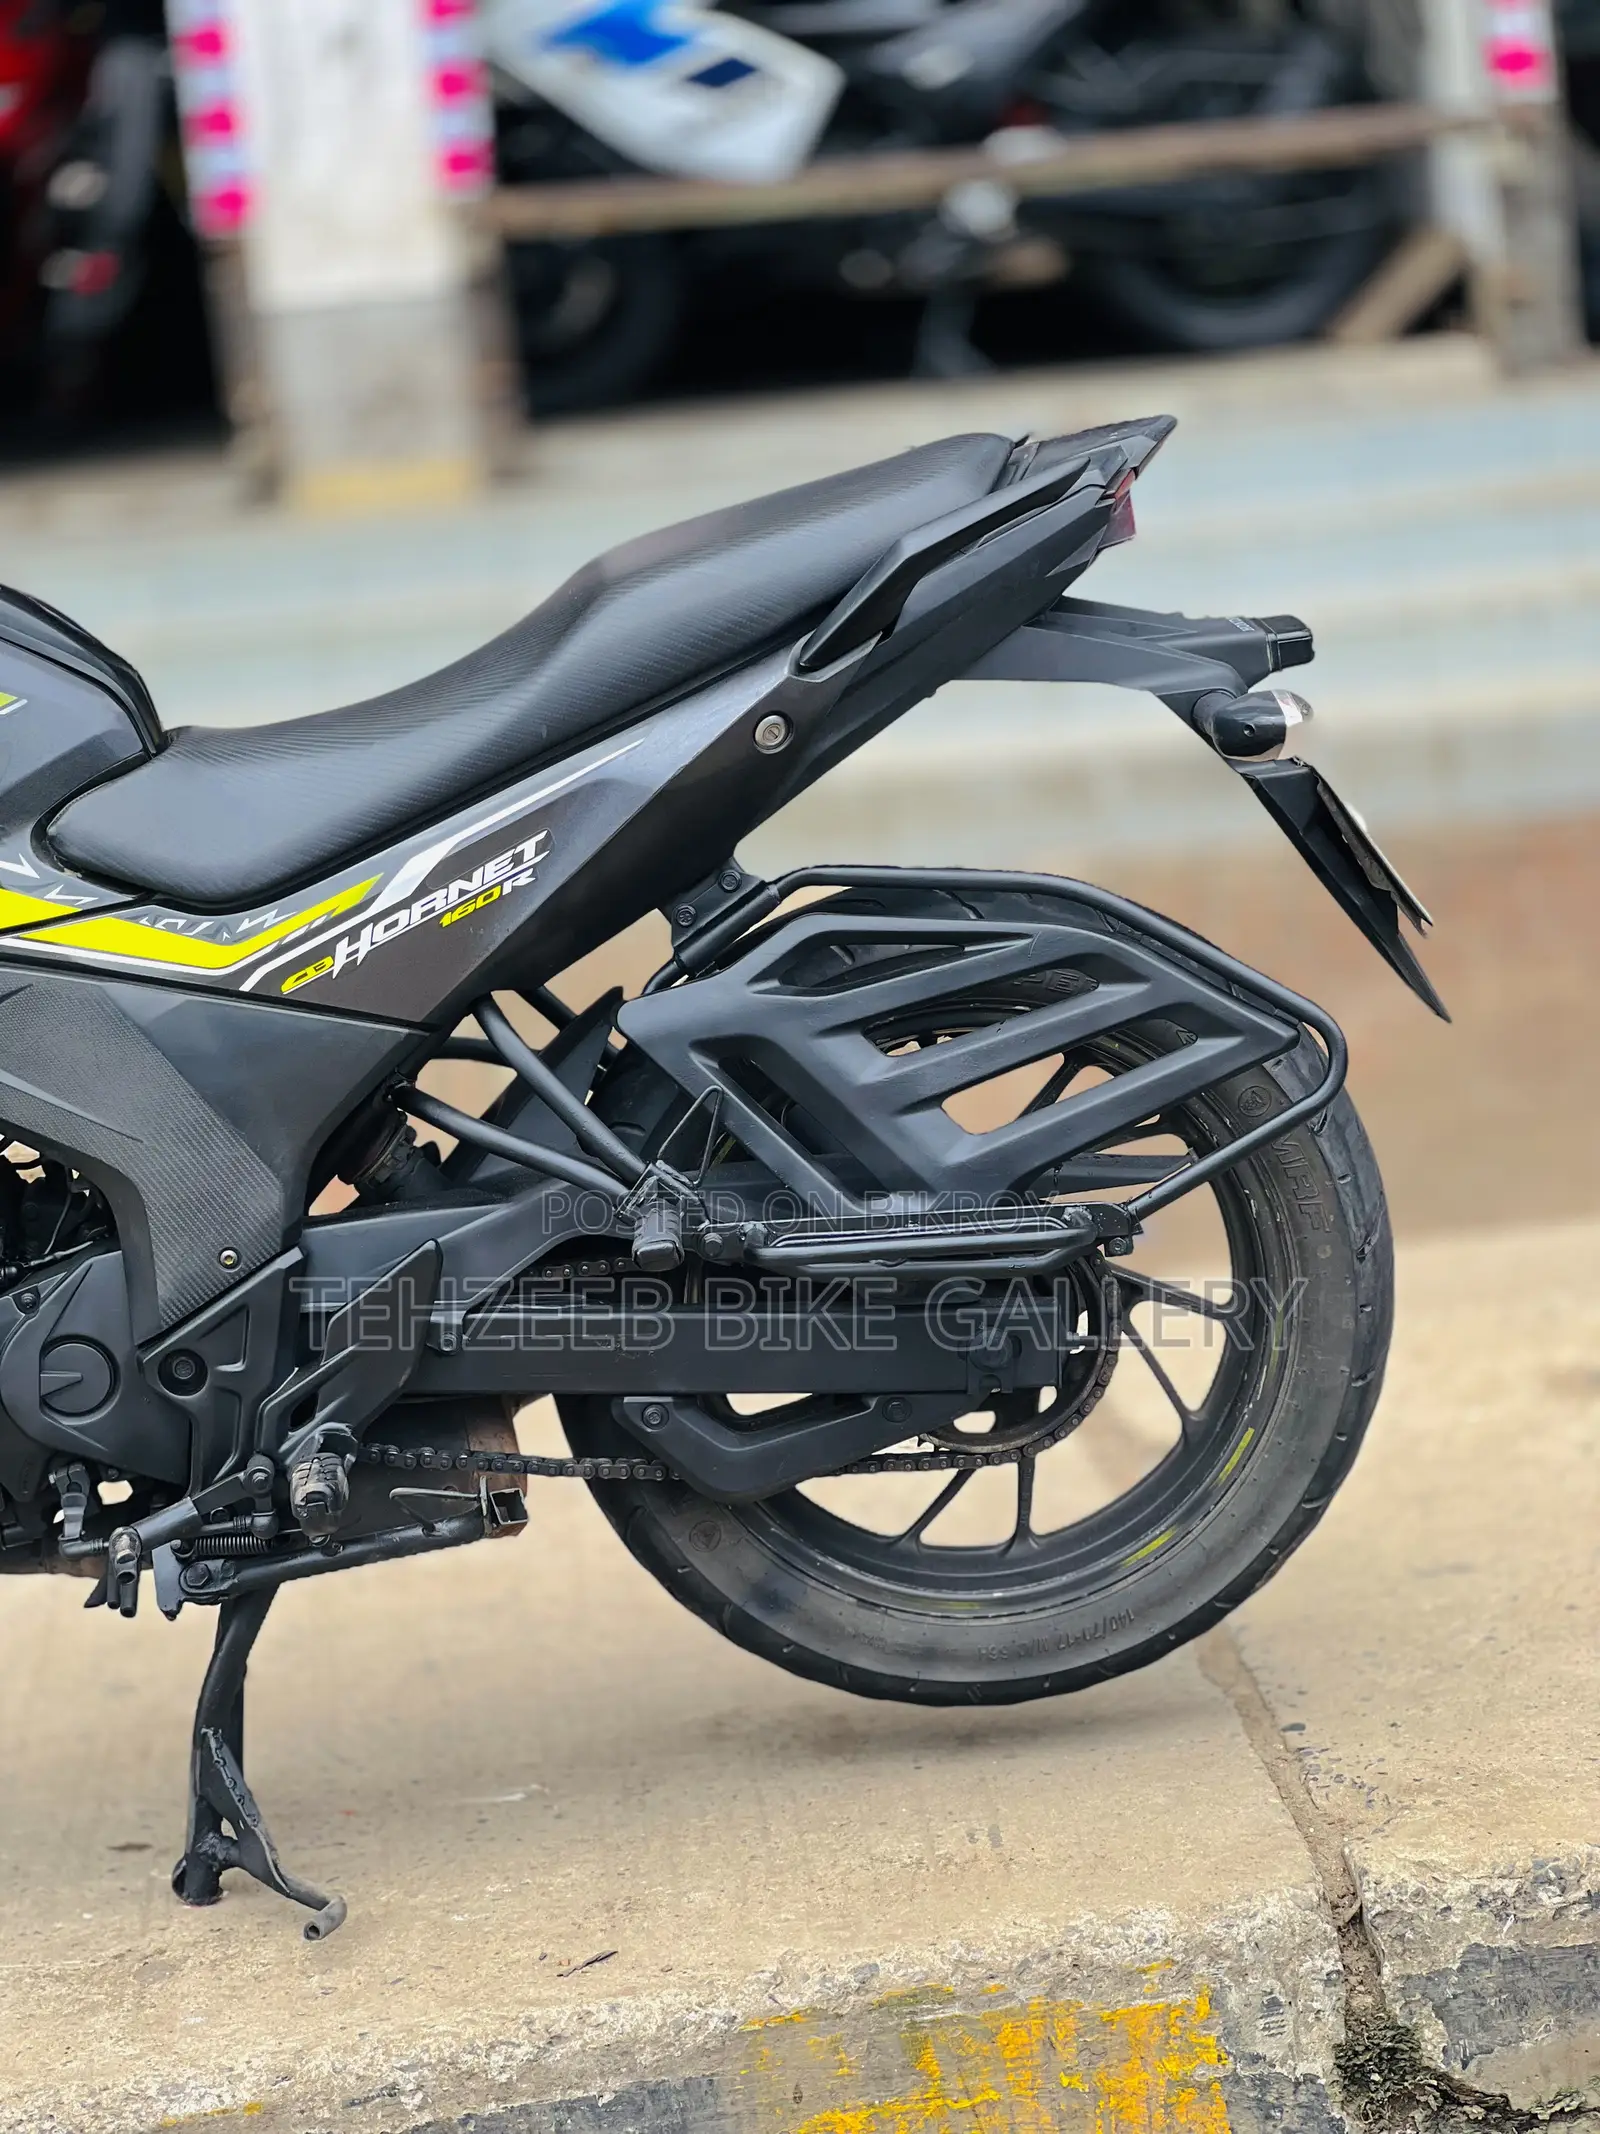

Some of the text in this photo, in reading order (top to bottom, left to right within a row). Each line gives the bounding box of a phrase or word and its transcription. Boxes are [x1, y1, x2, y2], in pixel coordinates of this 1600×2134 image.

[281, 830, 549, 993] CB HORNET
[439, 867, 536, 927] 160R
